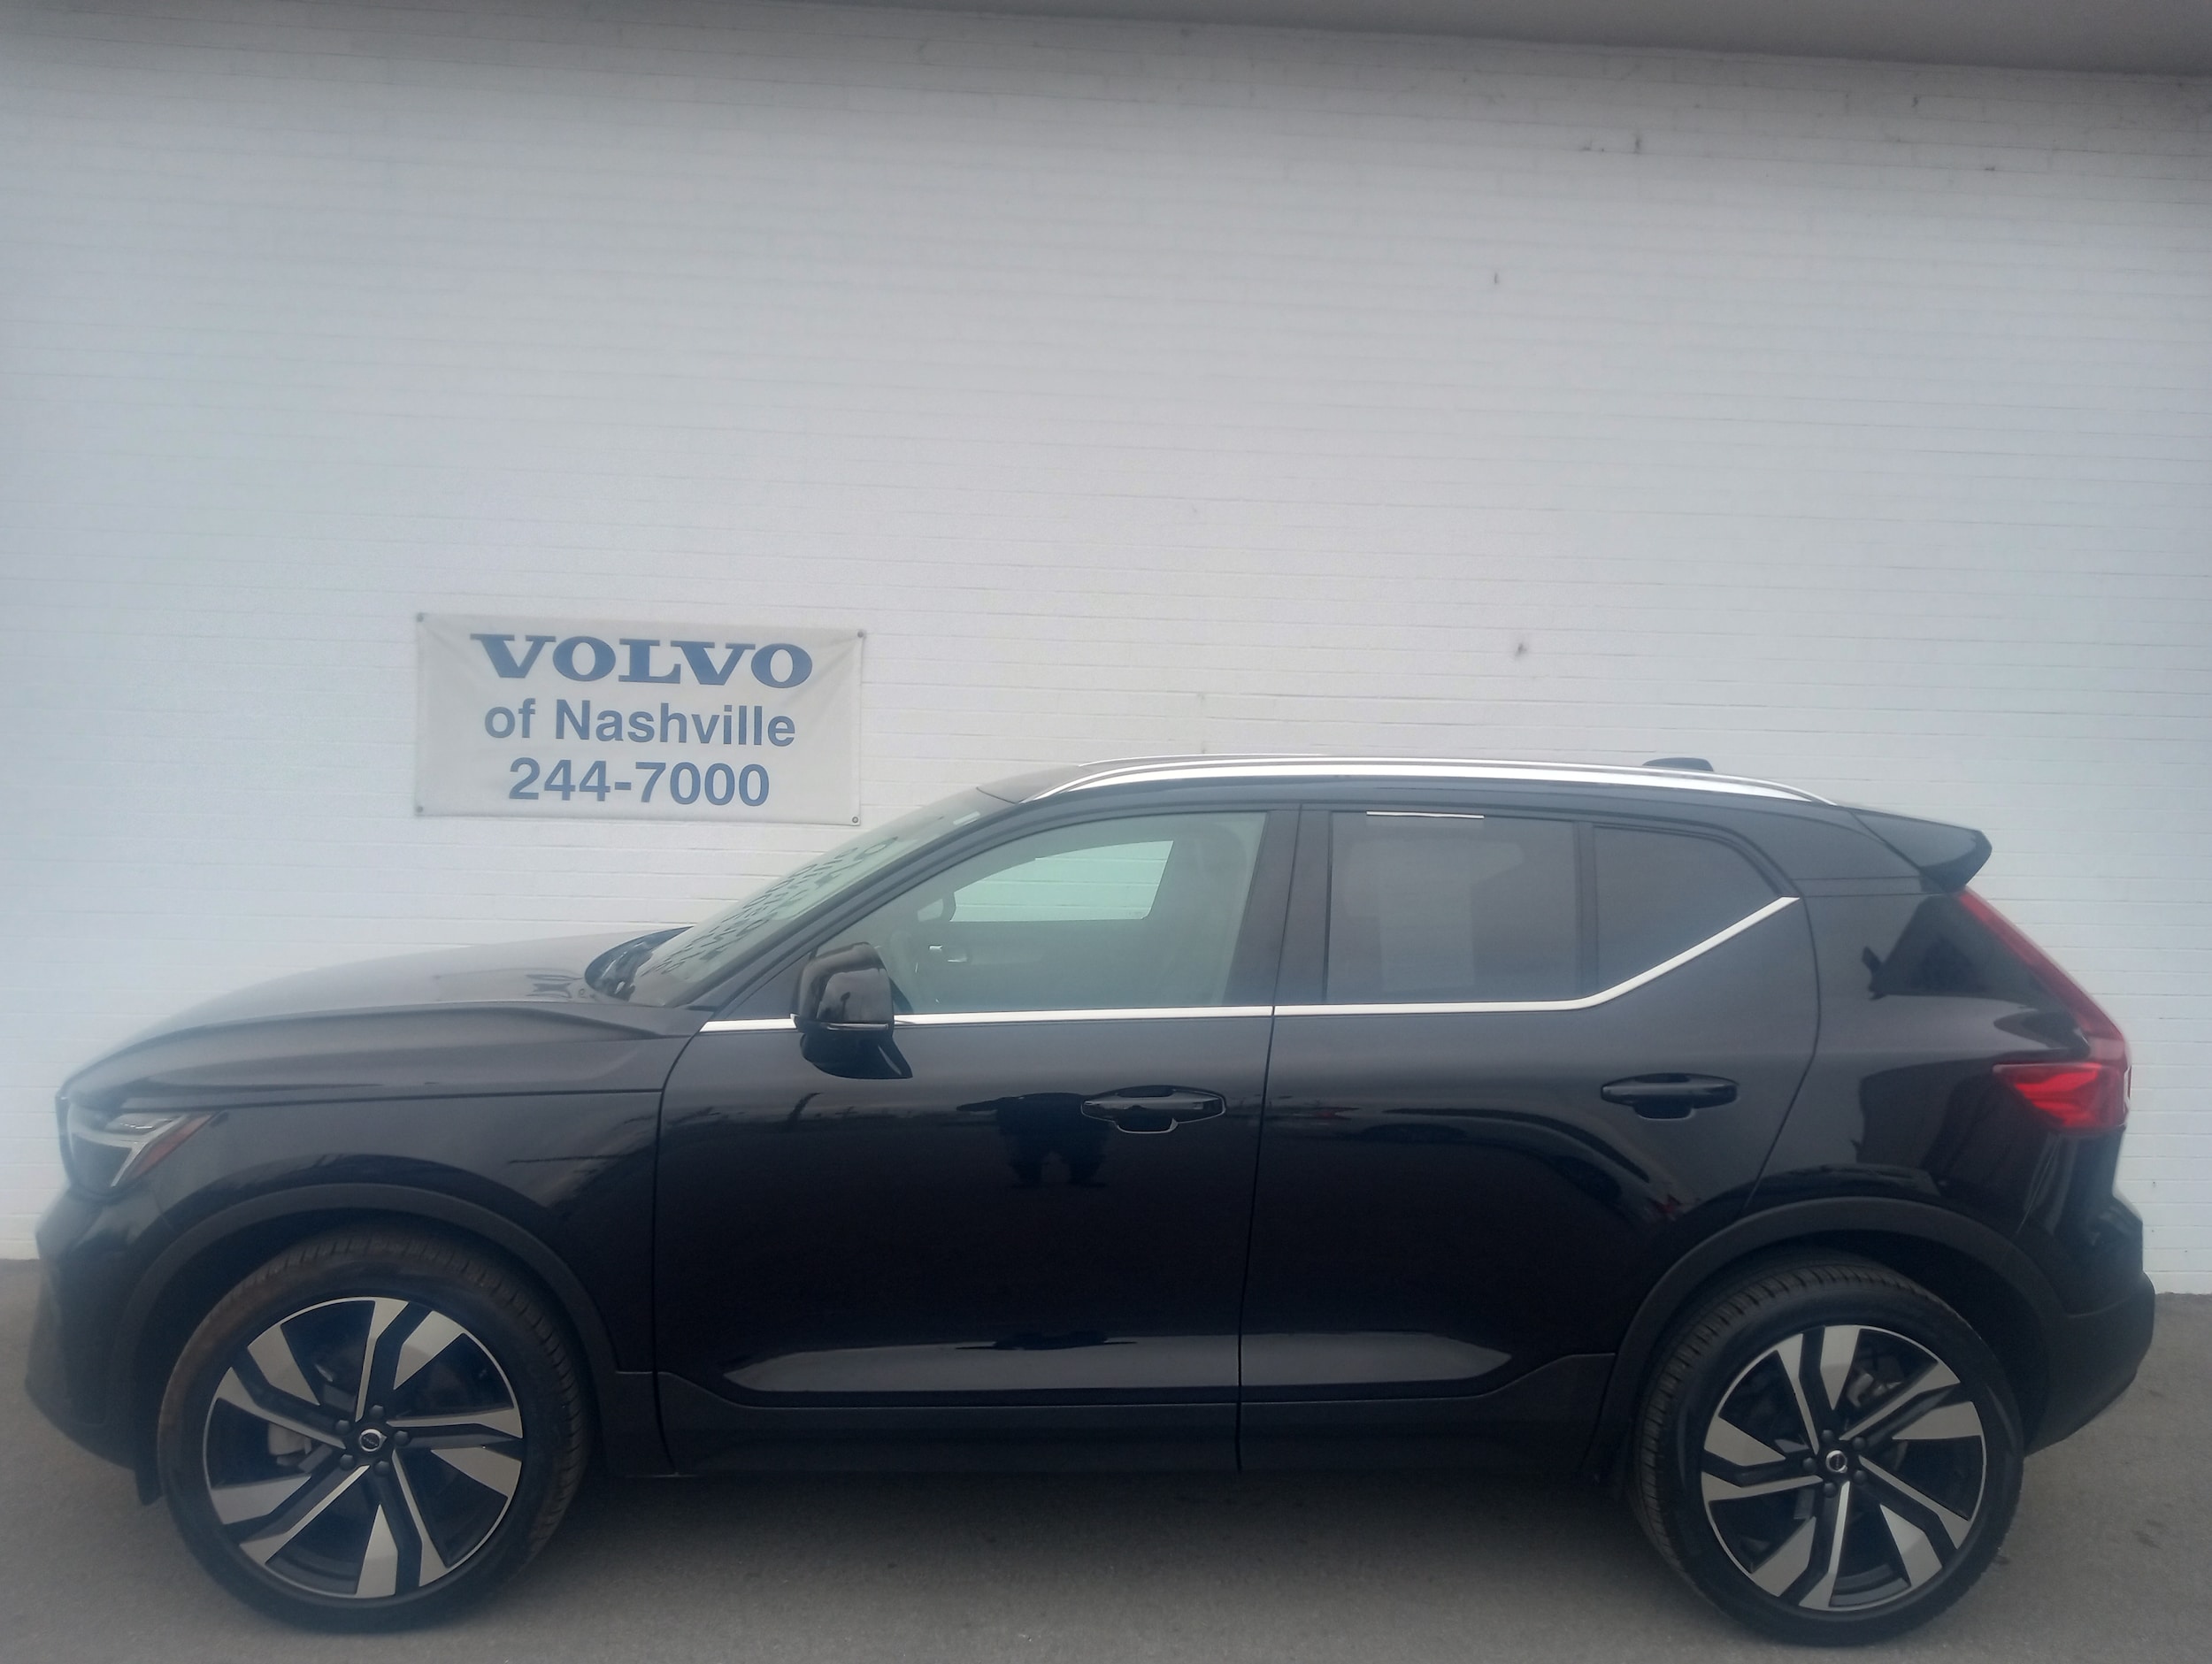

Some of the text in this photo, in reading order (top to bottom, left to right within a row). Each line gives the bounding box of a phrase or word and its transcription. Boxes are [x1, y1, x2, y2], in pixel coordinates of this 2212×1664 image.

[470, 633, 813, 688] VOLVO
[485, 698, 795, 747] of Nashville
[509, 757, 770, 806] 244-7000
